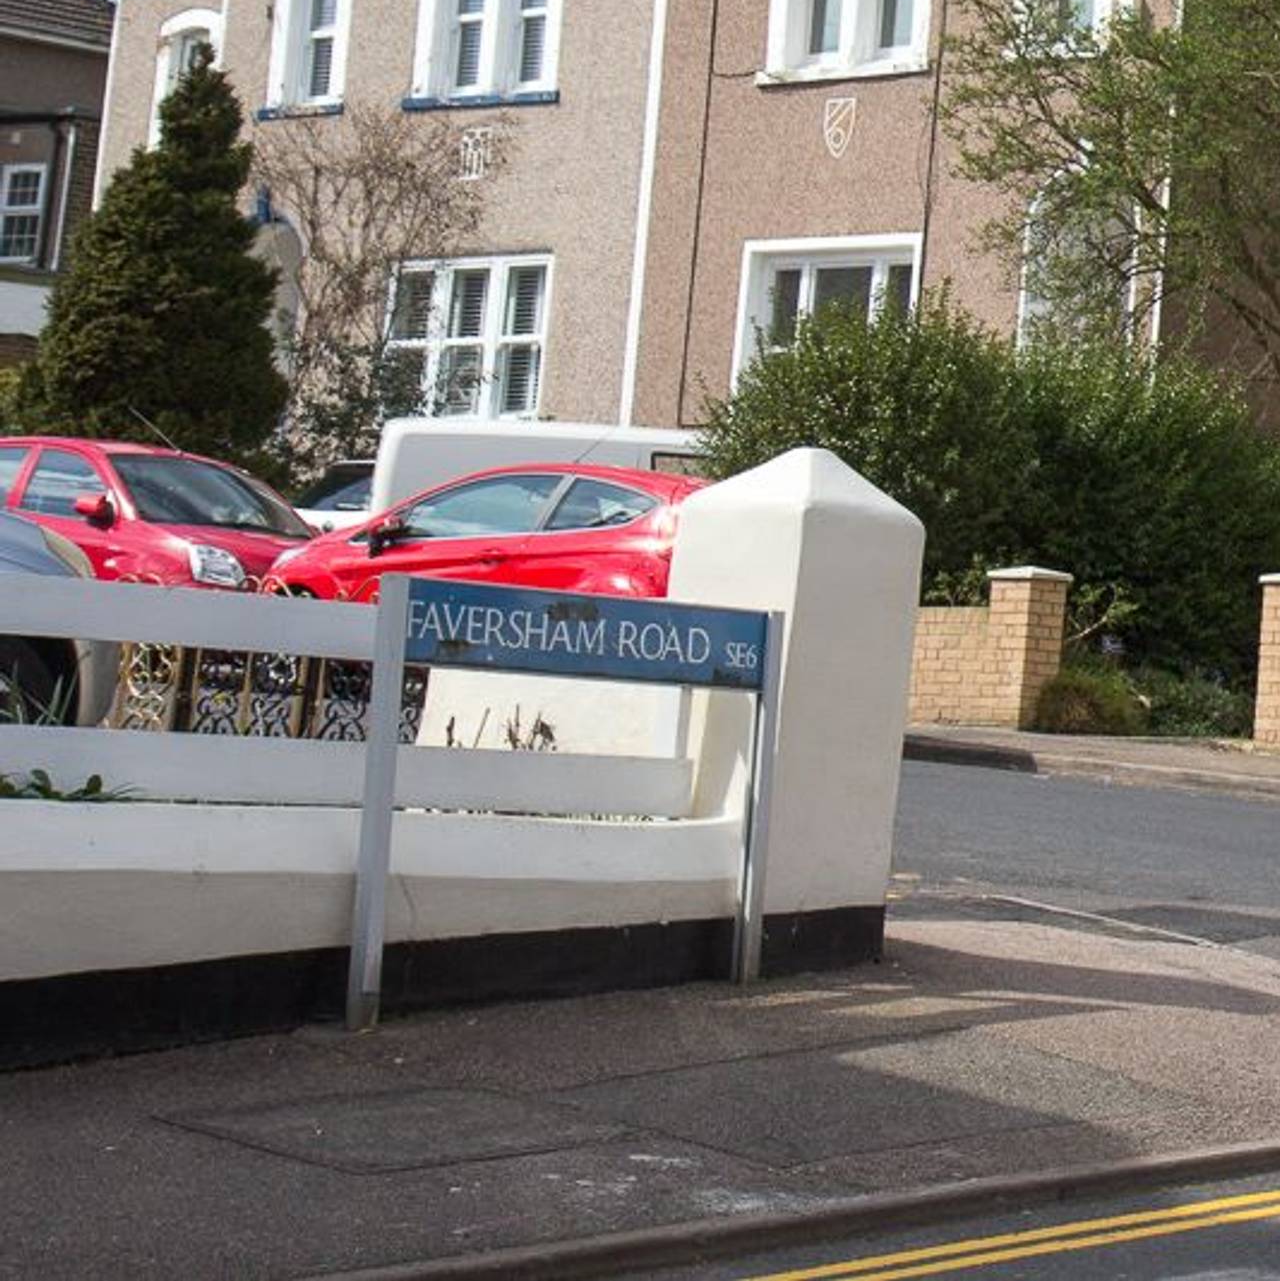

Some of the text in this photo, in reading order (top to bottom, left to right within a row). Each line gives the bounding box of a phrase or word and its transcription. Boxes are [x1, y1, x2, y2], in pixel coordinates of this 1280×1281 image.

[406, 599, 758, 669] FAVERSHAM ROAD SE6
